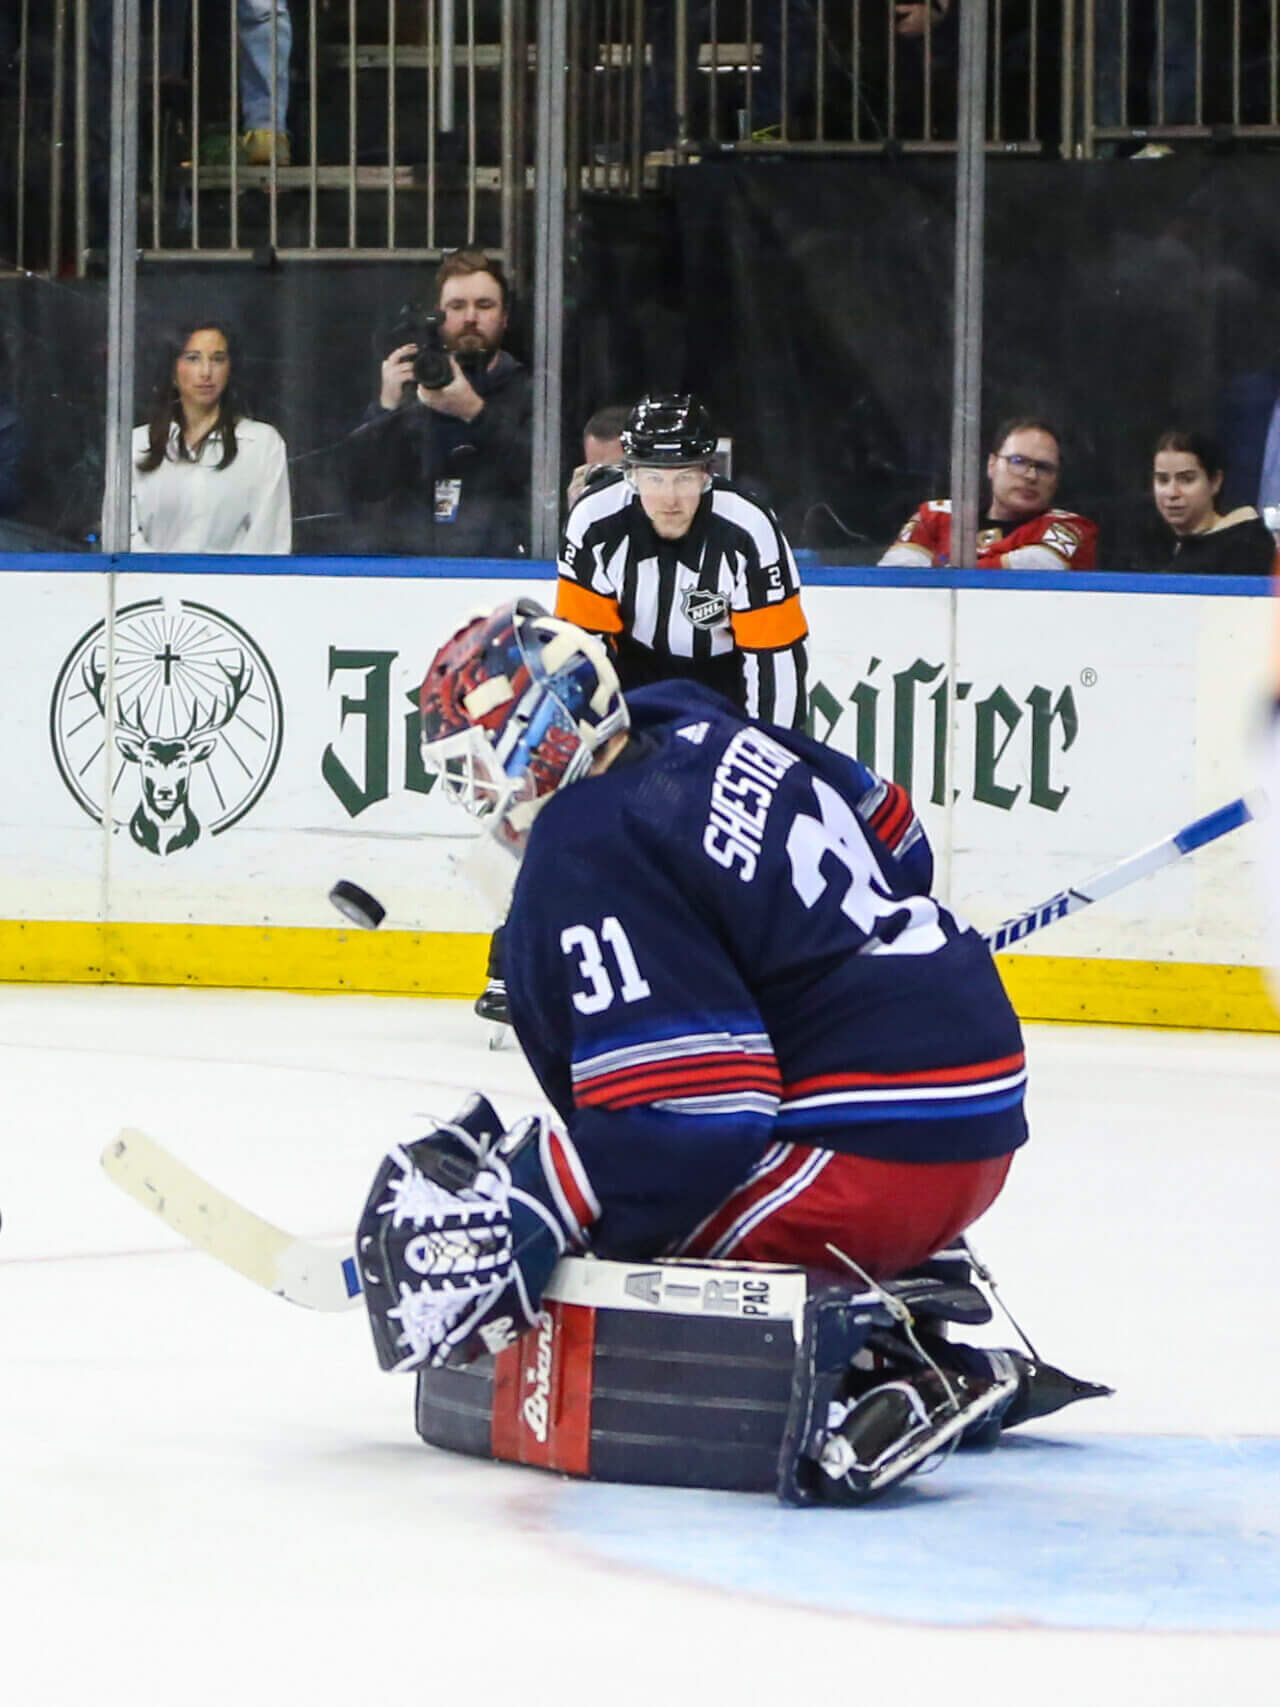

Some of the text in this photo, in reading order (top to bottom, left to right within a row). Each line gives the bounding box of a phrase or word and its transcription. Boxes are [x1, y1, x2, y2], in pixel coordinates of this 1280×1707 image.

[691, 602, 726, 619] NHL
[560, 916, 651, 1015] 31
[624, 1270, 770, 1317] AIR PAC
